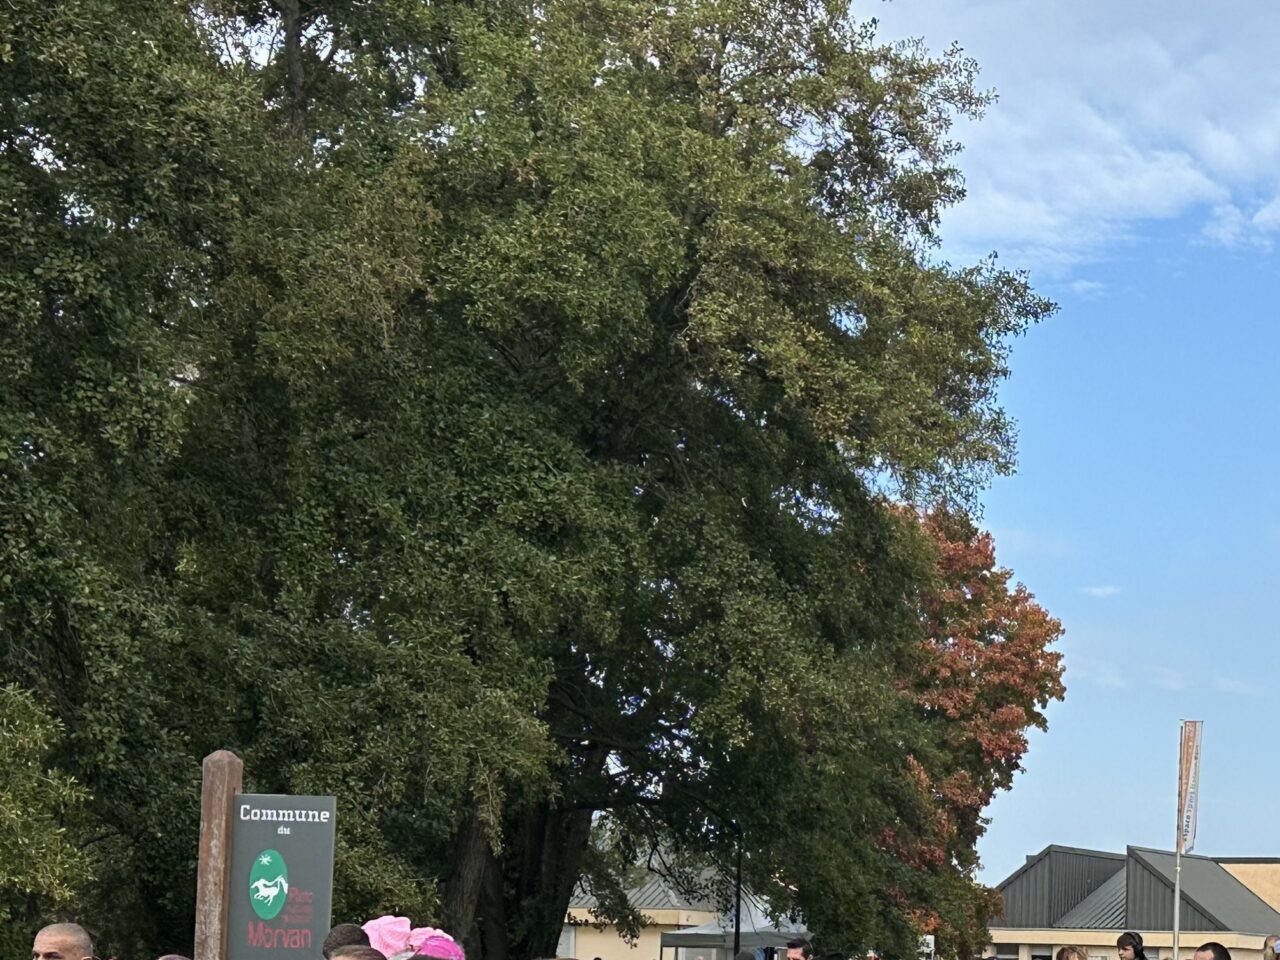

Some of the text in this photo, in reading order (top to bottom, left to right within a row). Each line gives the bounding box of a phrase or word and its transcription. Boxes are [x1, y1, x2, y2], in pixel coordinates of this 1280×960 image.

[240, 804, 330, 823] Commune
[277, 825, 291, 835] du
[247, 921, 312, 948] Morvan
